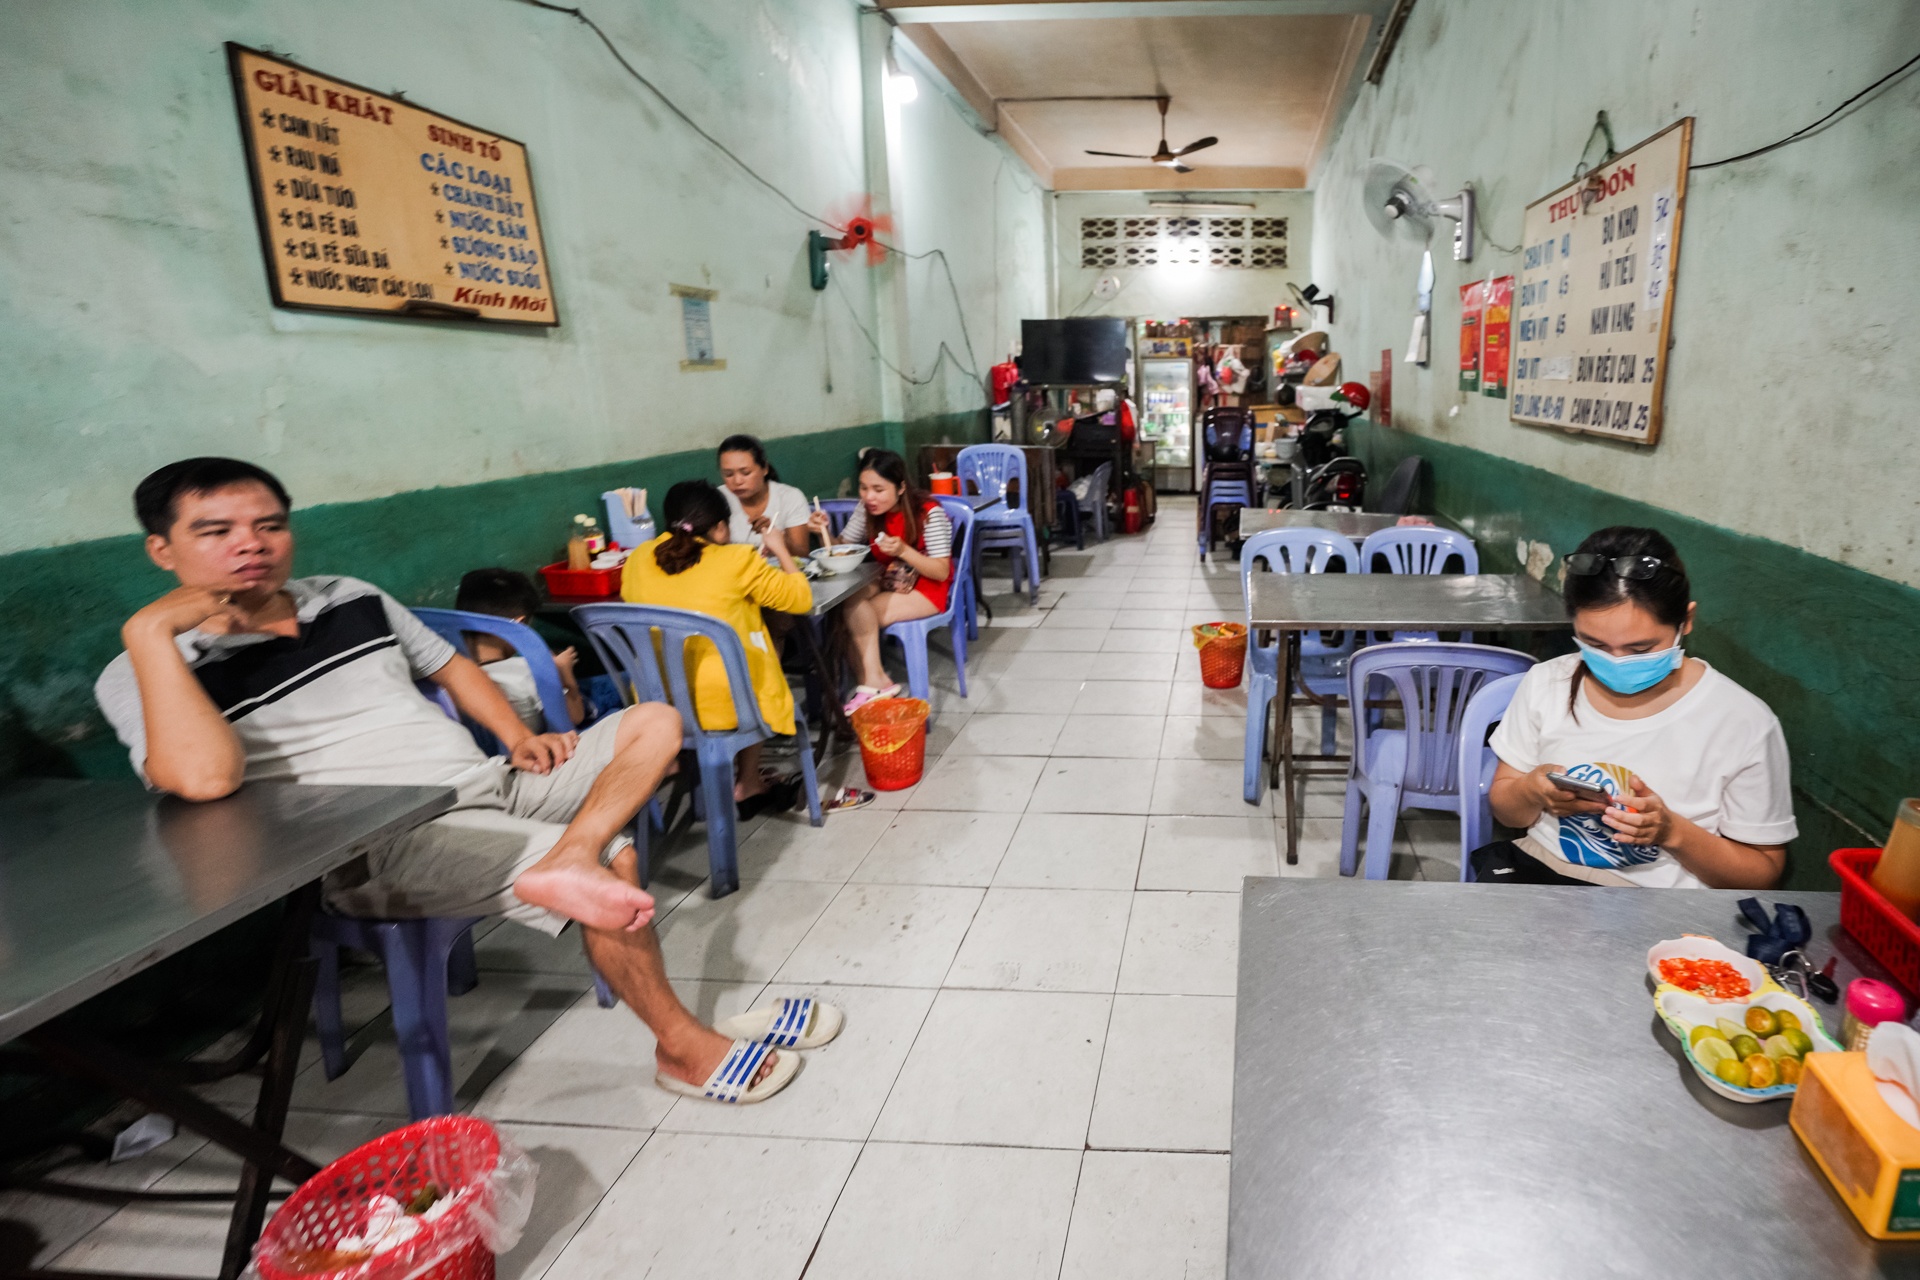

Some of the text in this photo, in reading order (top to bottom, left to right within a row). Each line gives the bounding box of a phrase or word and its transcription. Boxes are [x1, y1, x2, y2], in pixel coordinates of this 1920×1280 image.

[254, 69, 395, 125] GIẢI KHÁT
[278, 113, 312, 139] CAM
[284, 145, 317, 170] RAU
[427, 124, 502, 161] SINH TỐ
[420, 152, 512, 194] CÁC LOẠI
[443, 184, 495, 211] CHANH
[1617, 205, 1639, 240] KHO
[381, 275, 407, 297] CÁC
[453, 287, 506, 307] Kính
[1590, 301, 1635, 335] NAM VANG
[1617, 354, 1636, 383] CUA
[1641, 357, 1655, 383] 25
[1570, 398, 1593, 425] CANH
[1611, 400, 1633, 430] CUA
[1634, 404, 1649, 430] 25
